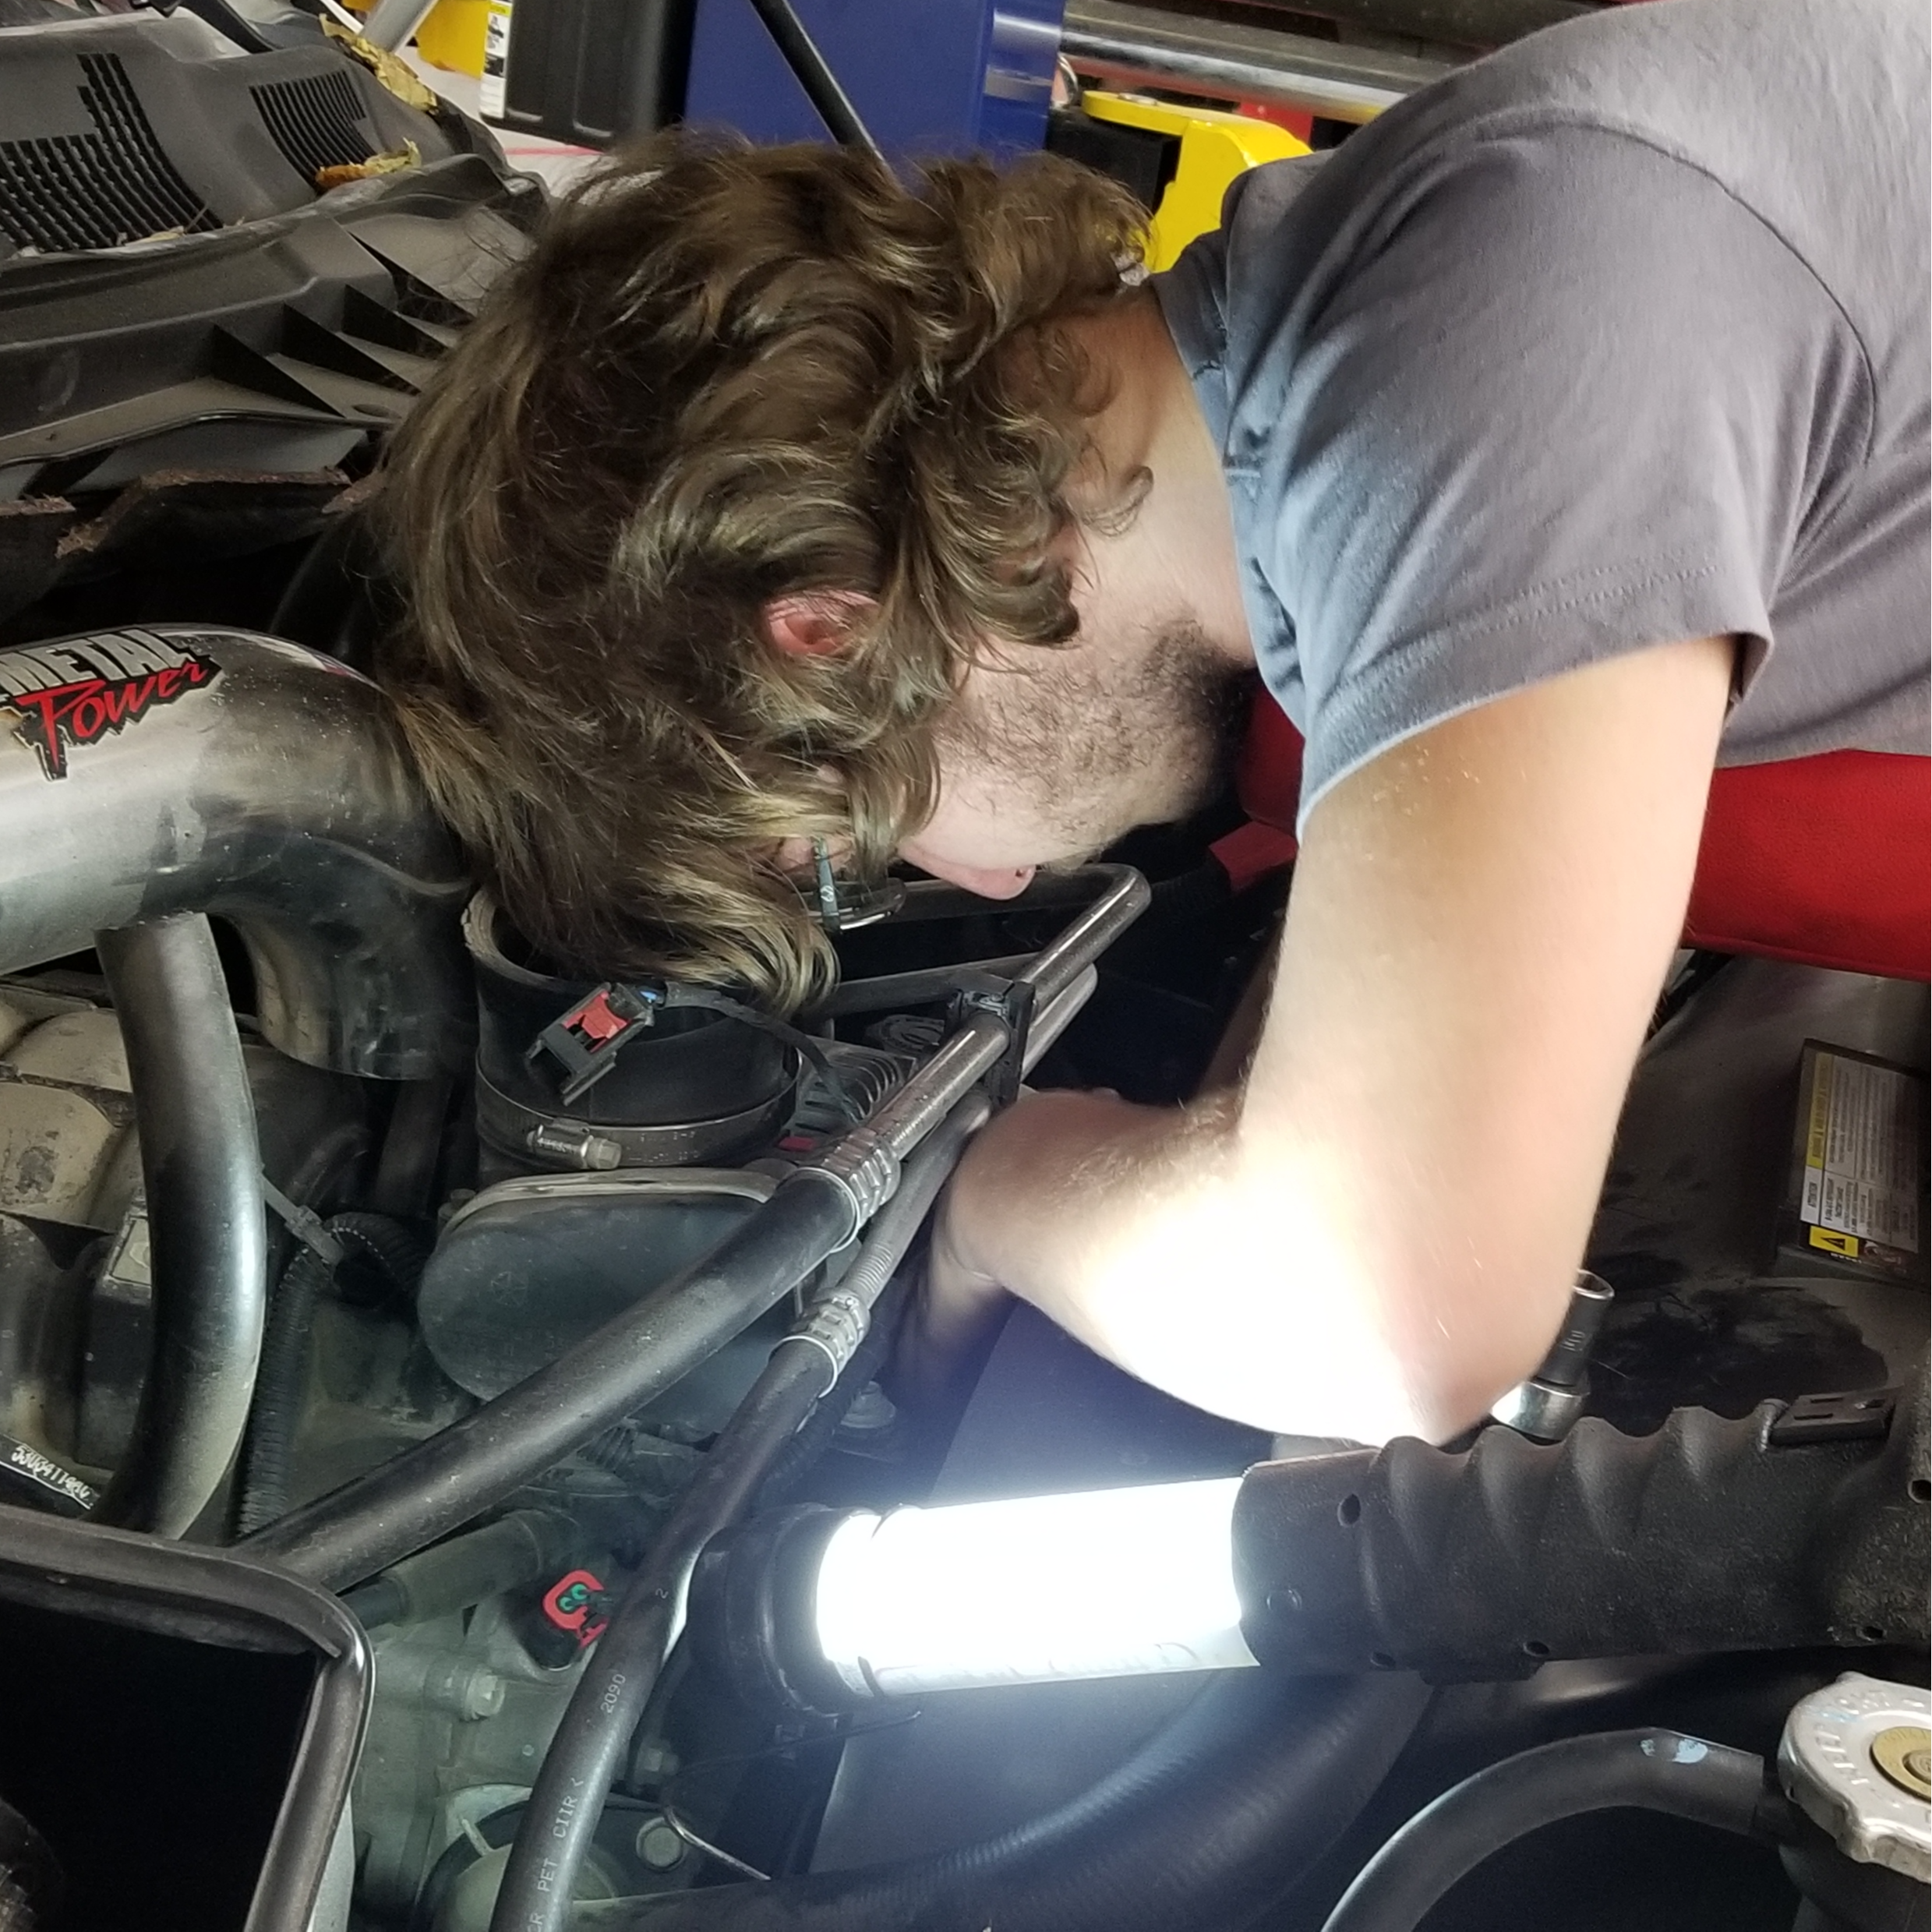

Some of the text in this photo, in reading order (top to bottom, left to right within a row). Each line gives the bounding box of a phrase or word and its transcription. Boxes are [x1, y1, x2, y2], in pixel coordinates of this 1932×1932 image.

[0, 629, 195, 696] METAL
[15, 662, 208, 769] Power
[537, 1857, 558, 1891] PET
